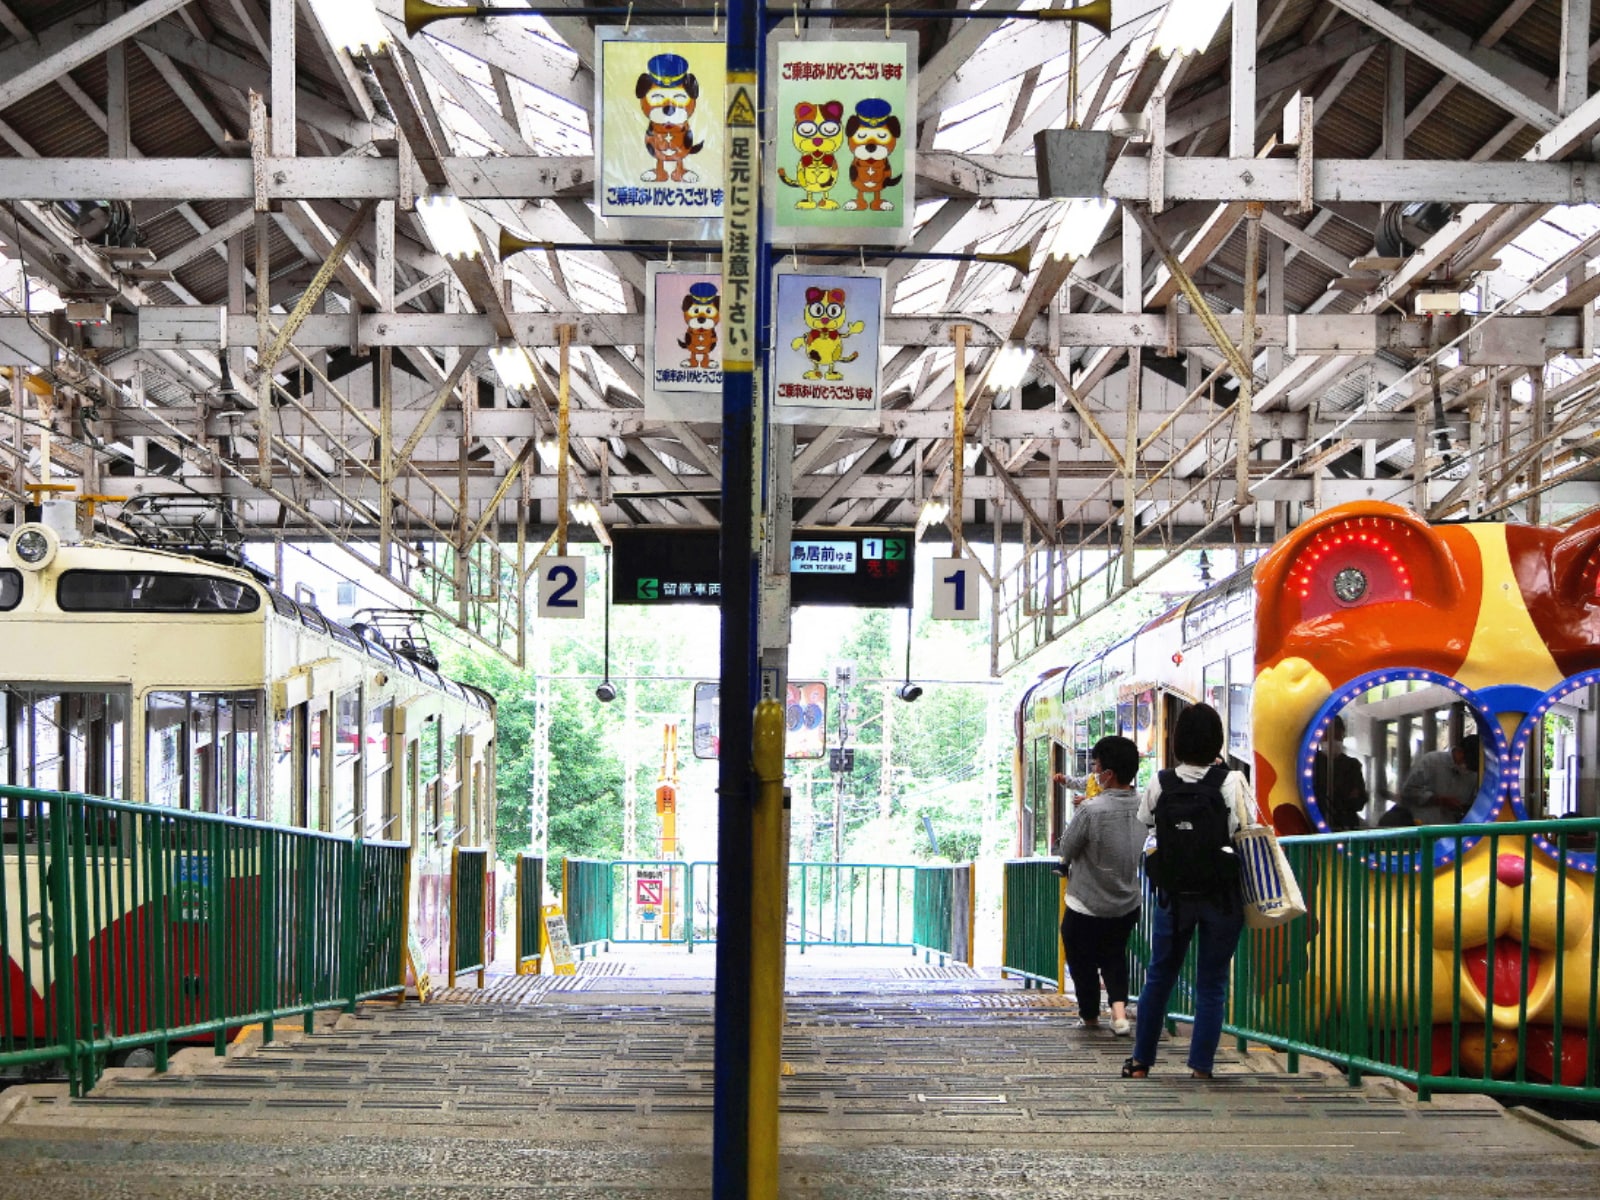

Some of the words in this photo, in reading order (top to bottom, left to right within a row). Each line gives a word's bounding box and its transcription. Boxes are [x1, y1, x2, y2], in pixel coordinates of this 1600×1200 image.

[782, 61, 904, 81] ご乗車ありがとうございます
[728, 137, 750, 356] 足元にご注意下さい。
[777, 383, 873, 401] ご乗車ありがとうございます
[792, 545, 853, 562] 鳥居前ゆき
[866, 541, 876, 557] 1
[547, 566, 578, 607] 2
[944, 570, 966, 610] 1
